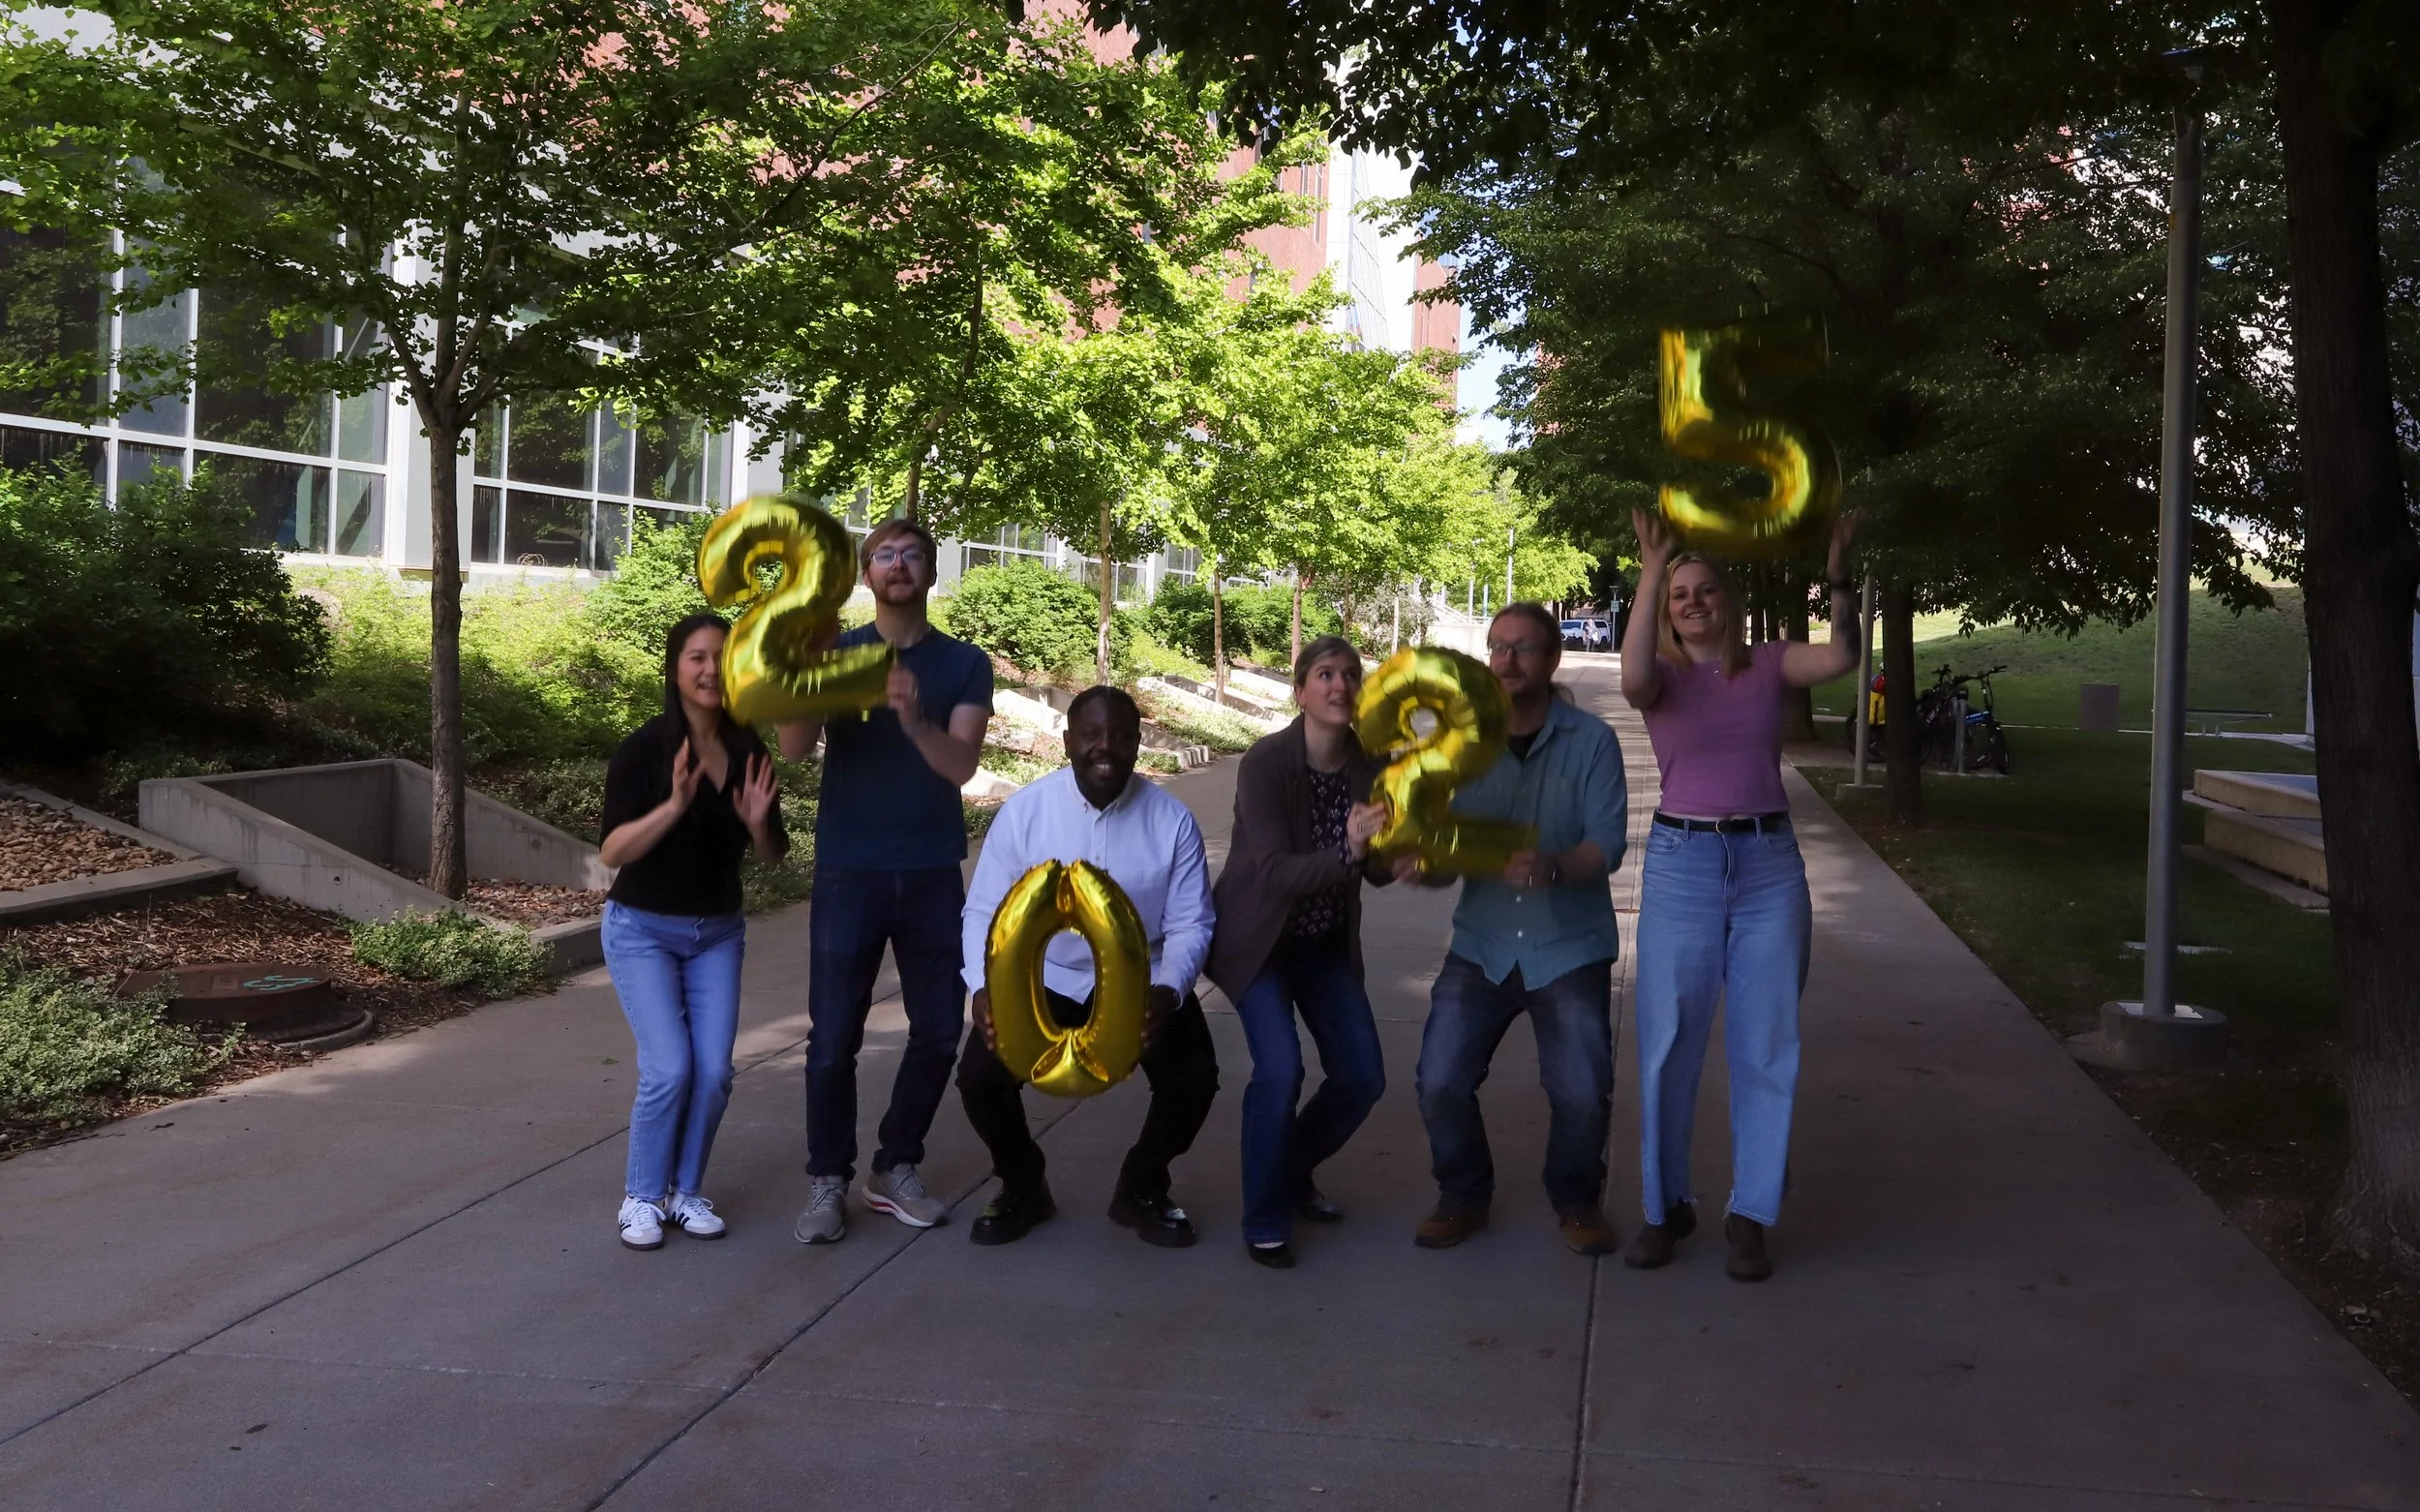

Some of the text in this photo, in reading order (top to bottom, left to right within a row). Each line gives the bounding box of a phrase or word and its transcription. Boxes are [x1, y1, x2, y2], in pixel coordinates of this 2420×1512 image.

[1659, 316, 1842, 558] 5
[697, 496, 896, 725] 2
[1353, 648, 1539, 876] 2
[984, 860, 1151, 1098] 0
